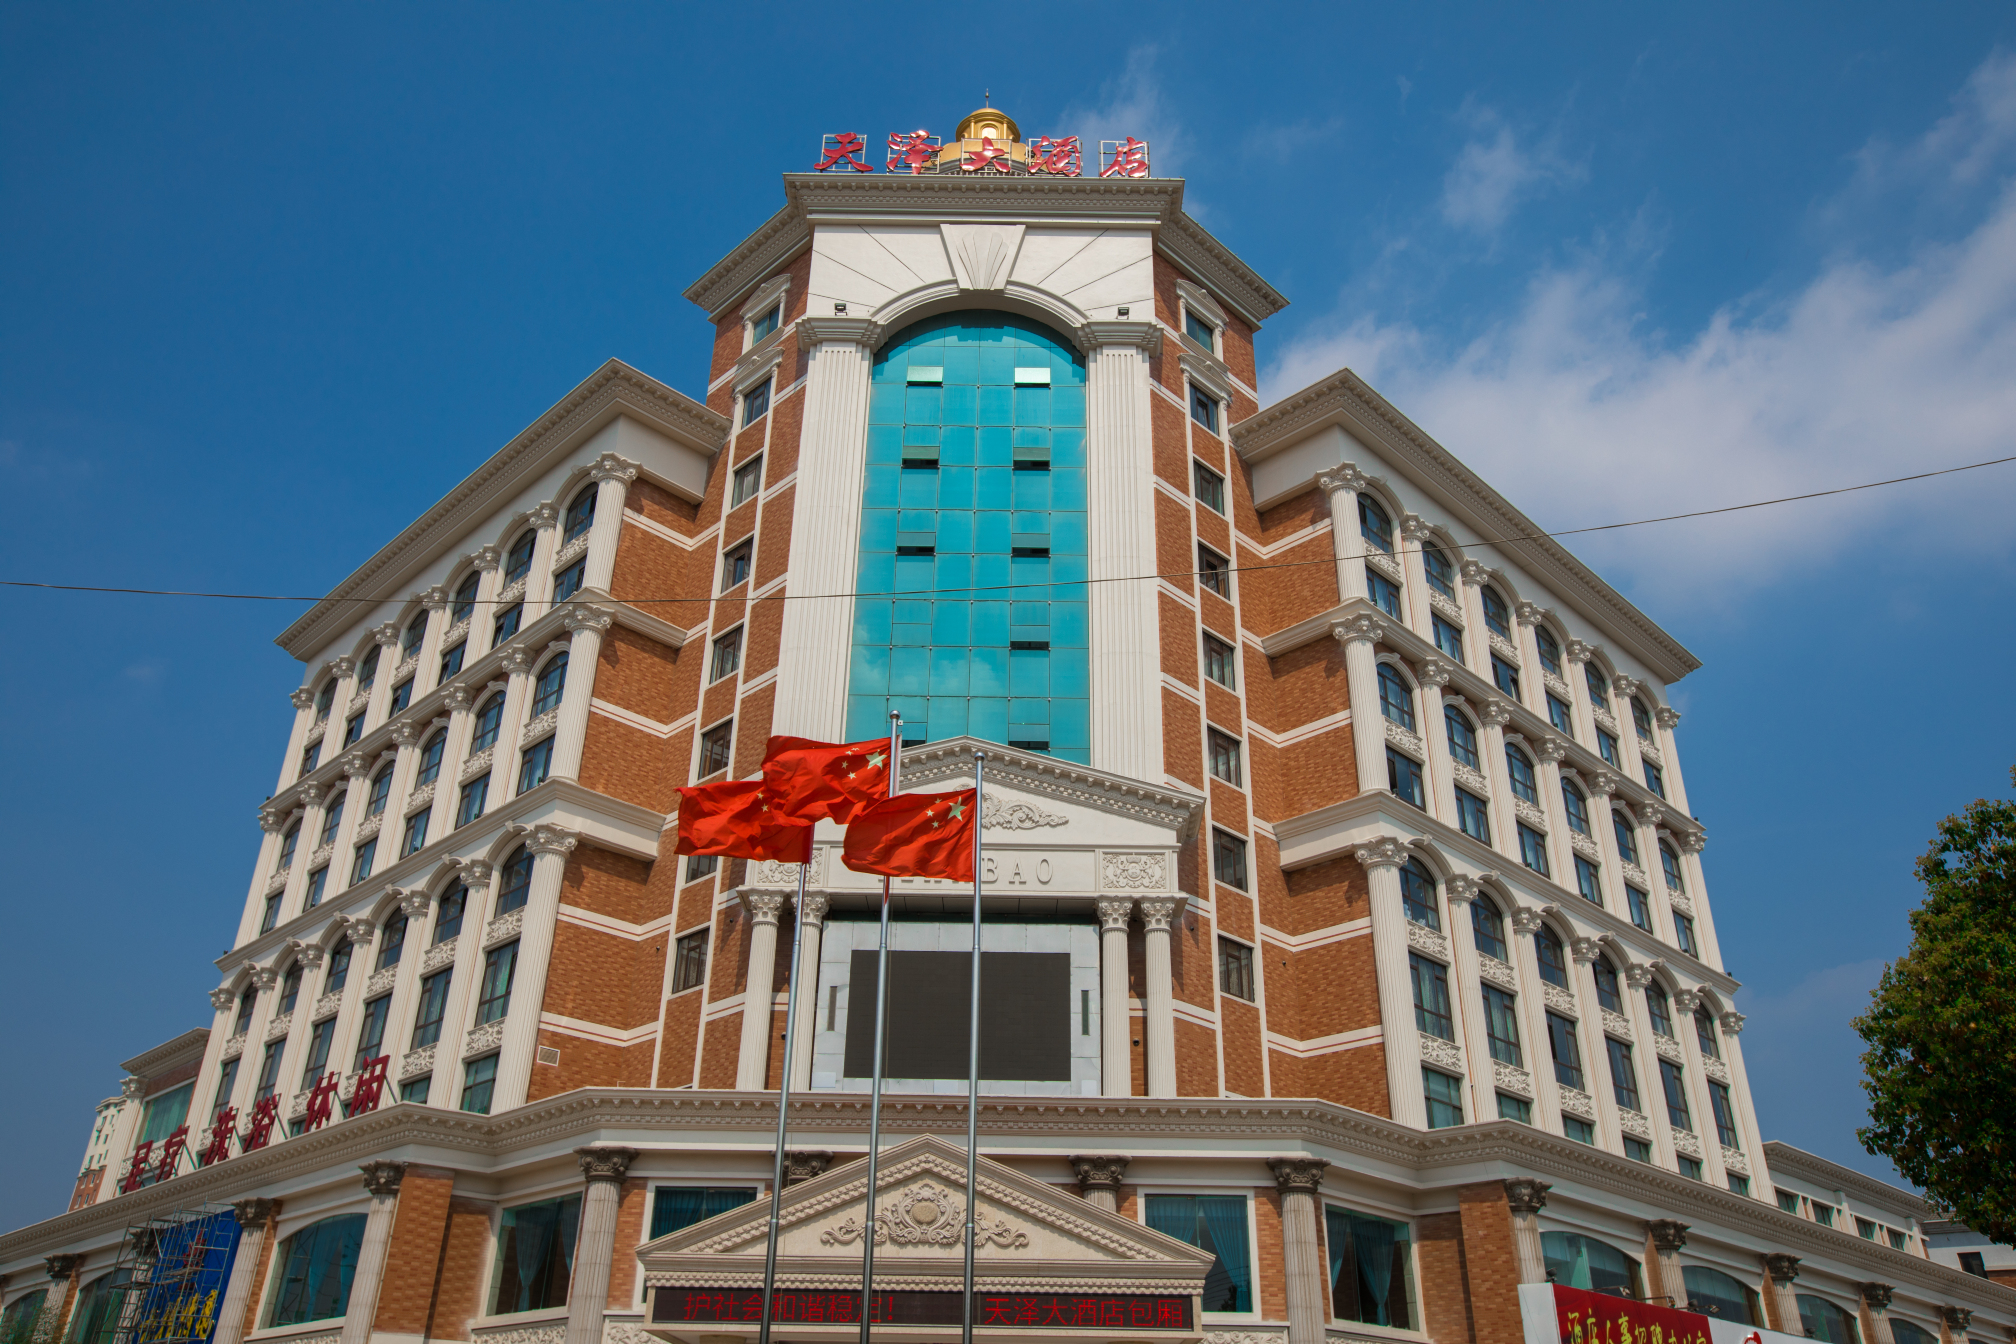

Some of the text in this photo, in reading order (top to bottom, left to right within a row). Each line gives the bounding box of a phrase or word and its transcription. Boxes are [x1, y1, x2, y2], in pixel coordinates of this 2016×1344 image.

[814, 130, 1149, 178] 天泽大酒店
